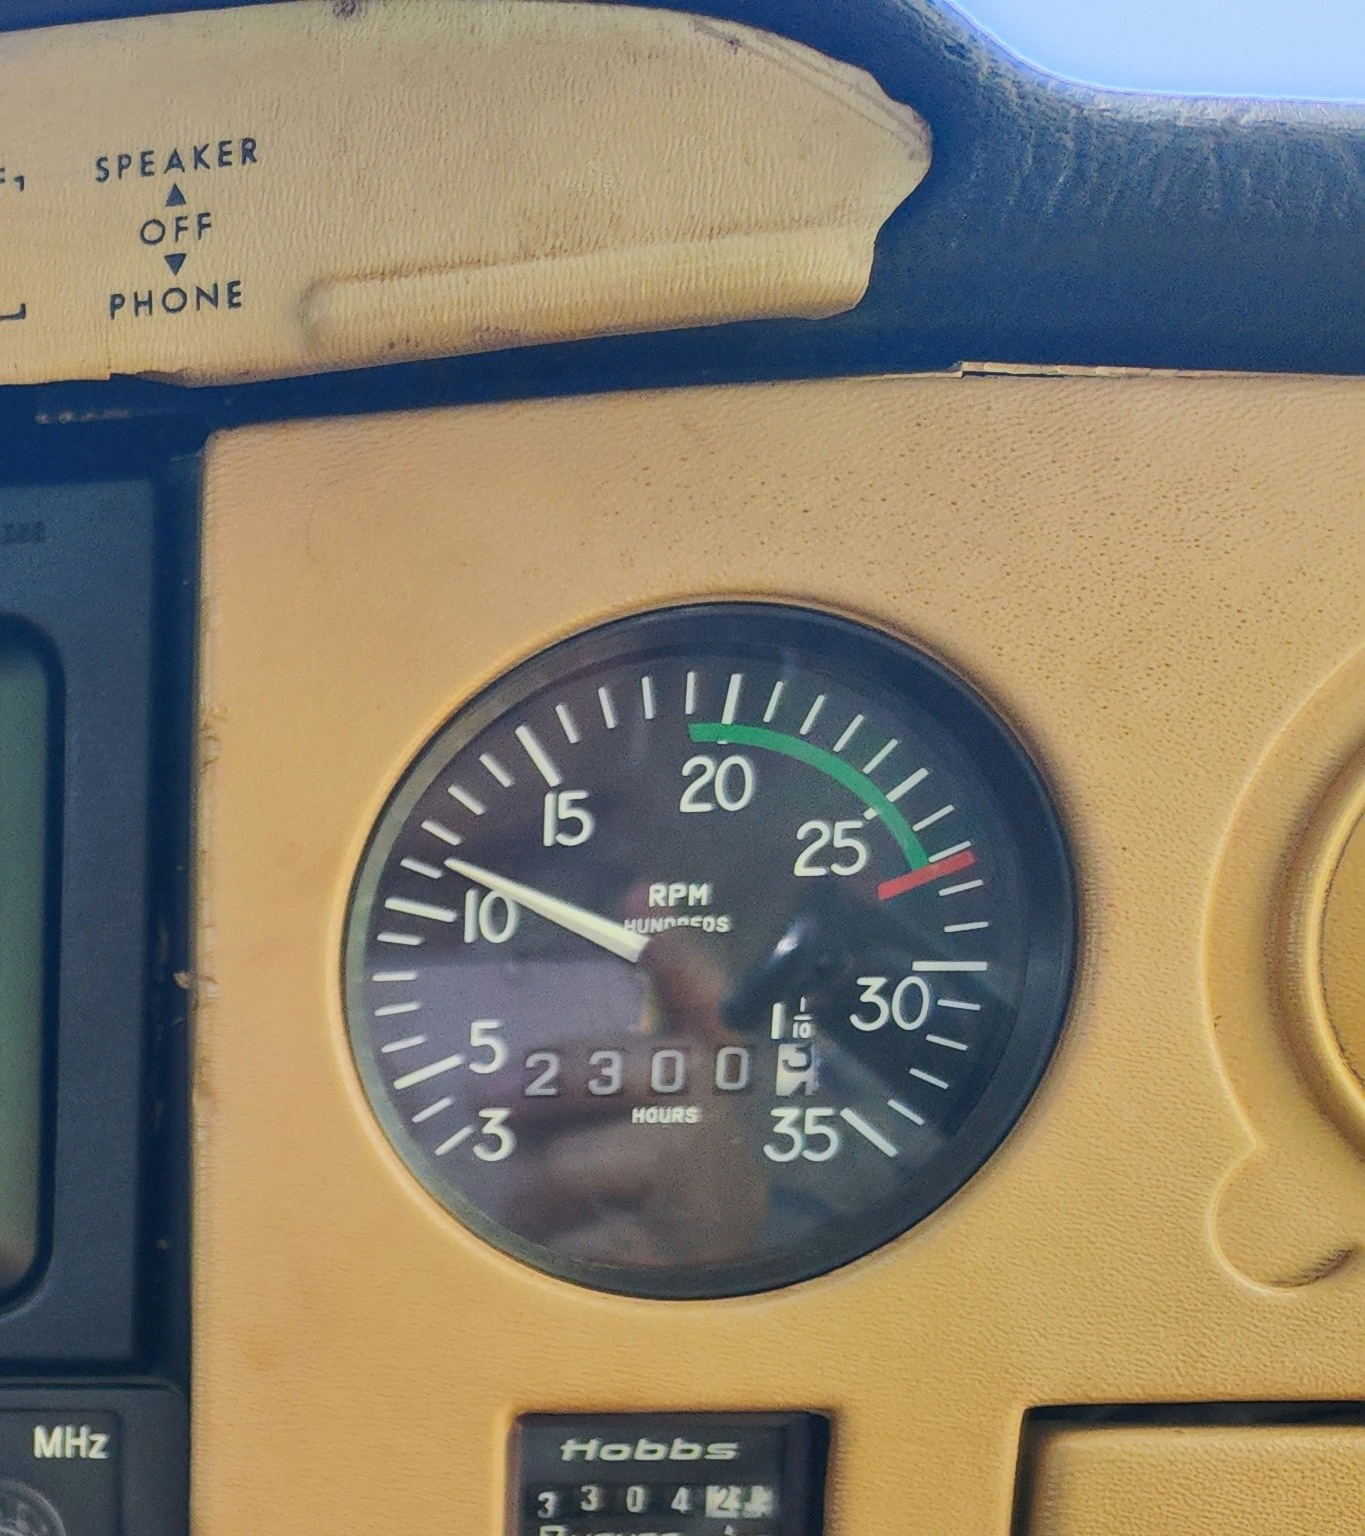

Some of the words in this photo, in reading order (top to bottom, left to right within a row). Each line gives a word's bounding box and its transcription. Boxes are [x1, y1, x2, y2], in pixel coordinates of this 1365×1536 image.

[95, 136, 262, 184] SPEAKER
[139, 212, 215, 248] OFF
[108, 280, 246, 323] PHONE
[679, 754, 756, 814] 20
[542, 789, 595, 848] 15
[793, 819, 868, 878] 25
[463, 888, 519, 945] 10
[647, 883, 709, 907] RPM
[849, 976, 931, 1032] 30
[468, 1018, 508, 1077] 5
[472, 1106, 517, 1164] 3
[631, 1105, 702, 1126] HOURS
[763, 1106, 839, 1164] 35
[33, 1425, 110, 1460] MHz
[559, 1437, 741, 1462] Hobbs
